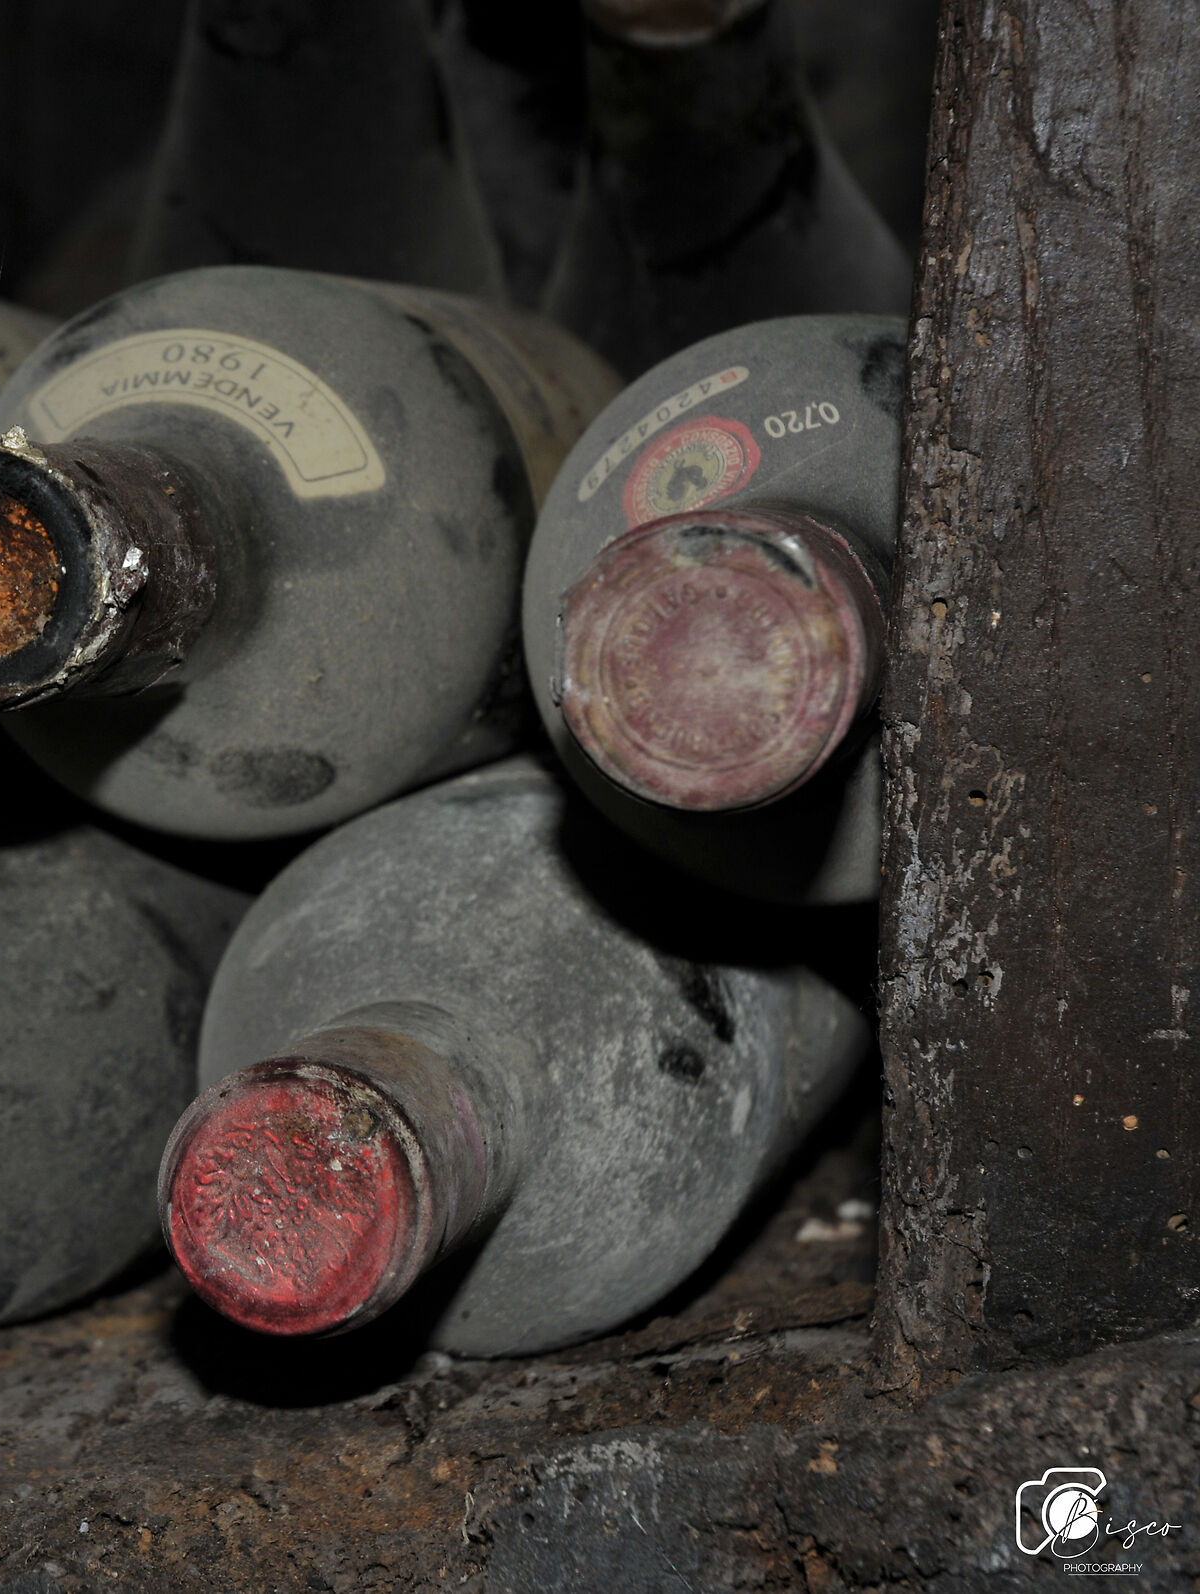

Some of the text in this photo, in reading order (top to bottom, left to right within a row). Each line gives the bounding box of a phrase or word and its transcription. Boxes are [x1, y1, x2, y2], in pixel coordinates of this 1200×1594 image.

[161, 343, 267, 379] 1980
[100, 369, 295, 439] VENDEMMIA
[763, 400, 841, 439] 0,720
